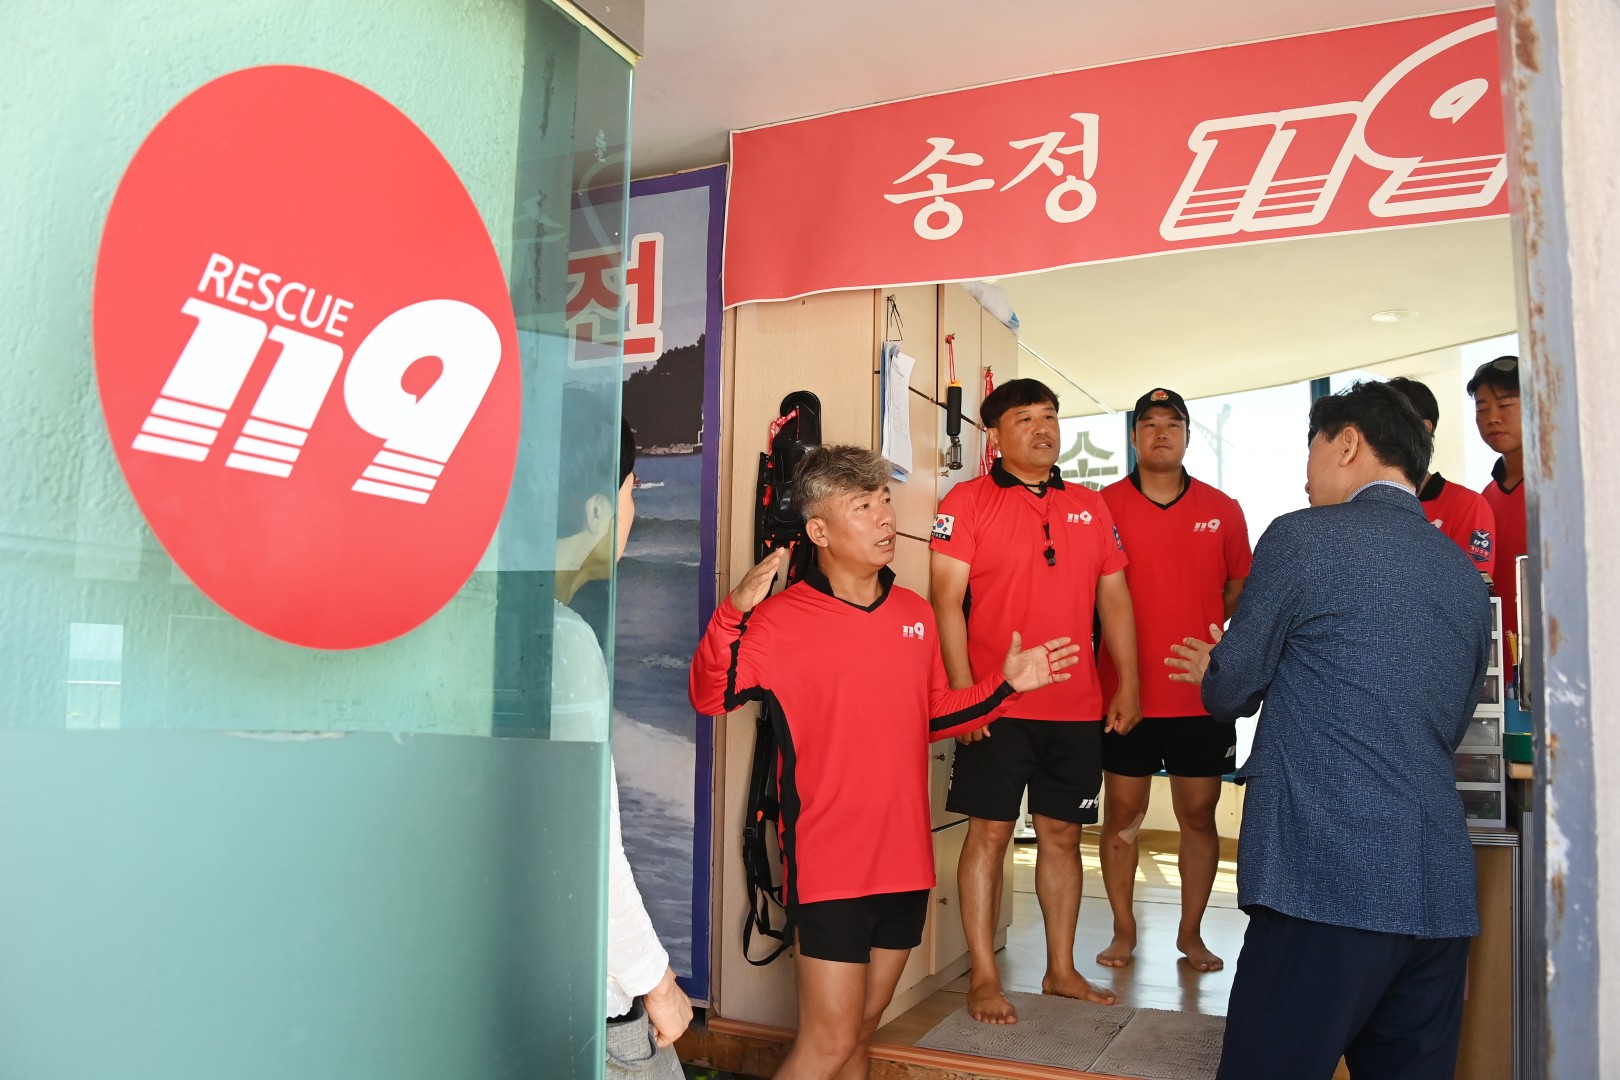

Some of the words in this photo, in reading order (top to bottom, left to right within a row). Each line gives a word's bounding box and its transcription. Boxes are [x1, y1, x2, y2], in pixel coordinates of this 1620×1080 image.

[884, 113, 1100, 241] 송정
[197, 252, 355, 338] RESCUE
[131, 297, 502, 505] 119
[1067, 510, 1093, 525] 119
[1194, 518, 1221, 533] 119
[902, 622, 925, 640] 119
